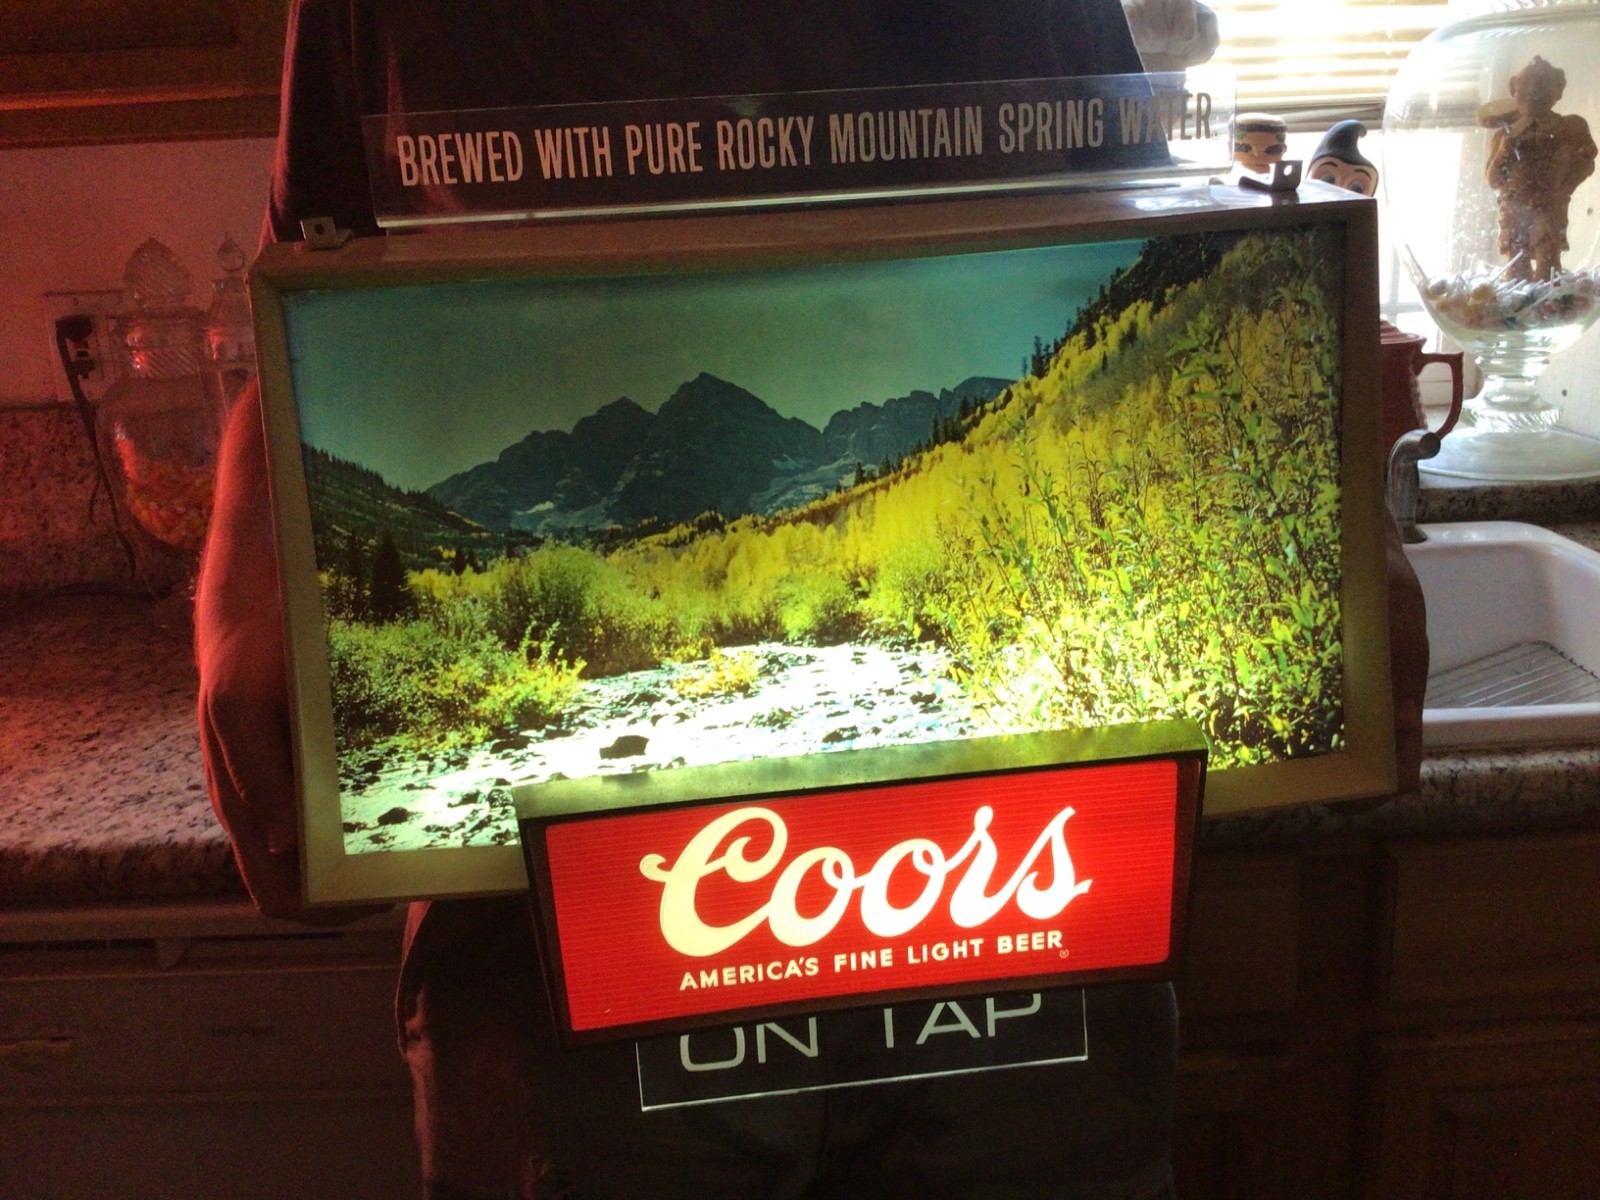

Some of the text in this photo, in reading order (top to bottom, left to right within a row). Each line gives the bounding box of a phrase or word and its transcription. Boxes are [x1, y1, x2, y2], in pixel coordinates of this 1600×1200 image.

[396, 92, 1212, 186] BREWED WITH PURE ROCKY MOUNTAIN SPRING WATER
[639, 804, 1094, 958] Coors
[679, 930, 1063, 991] AMERICA'S FINE LIGHT BEER
[679, 1016, 819, 1072] ON
